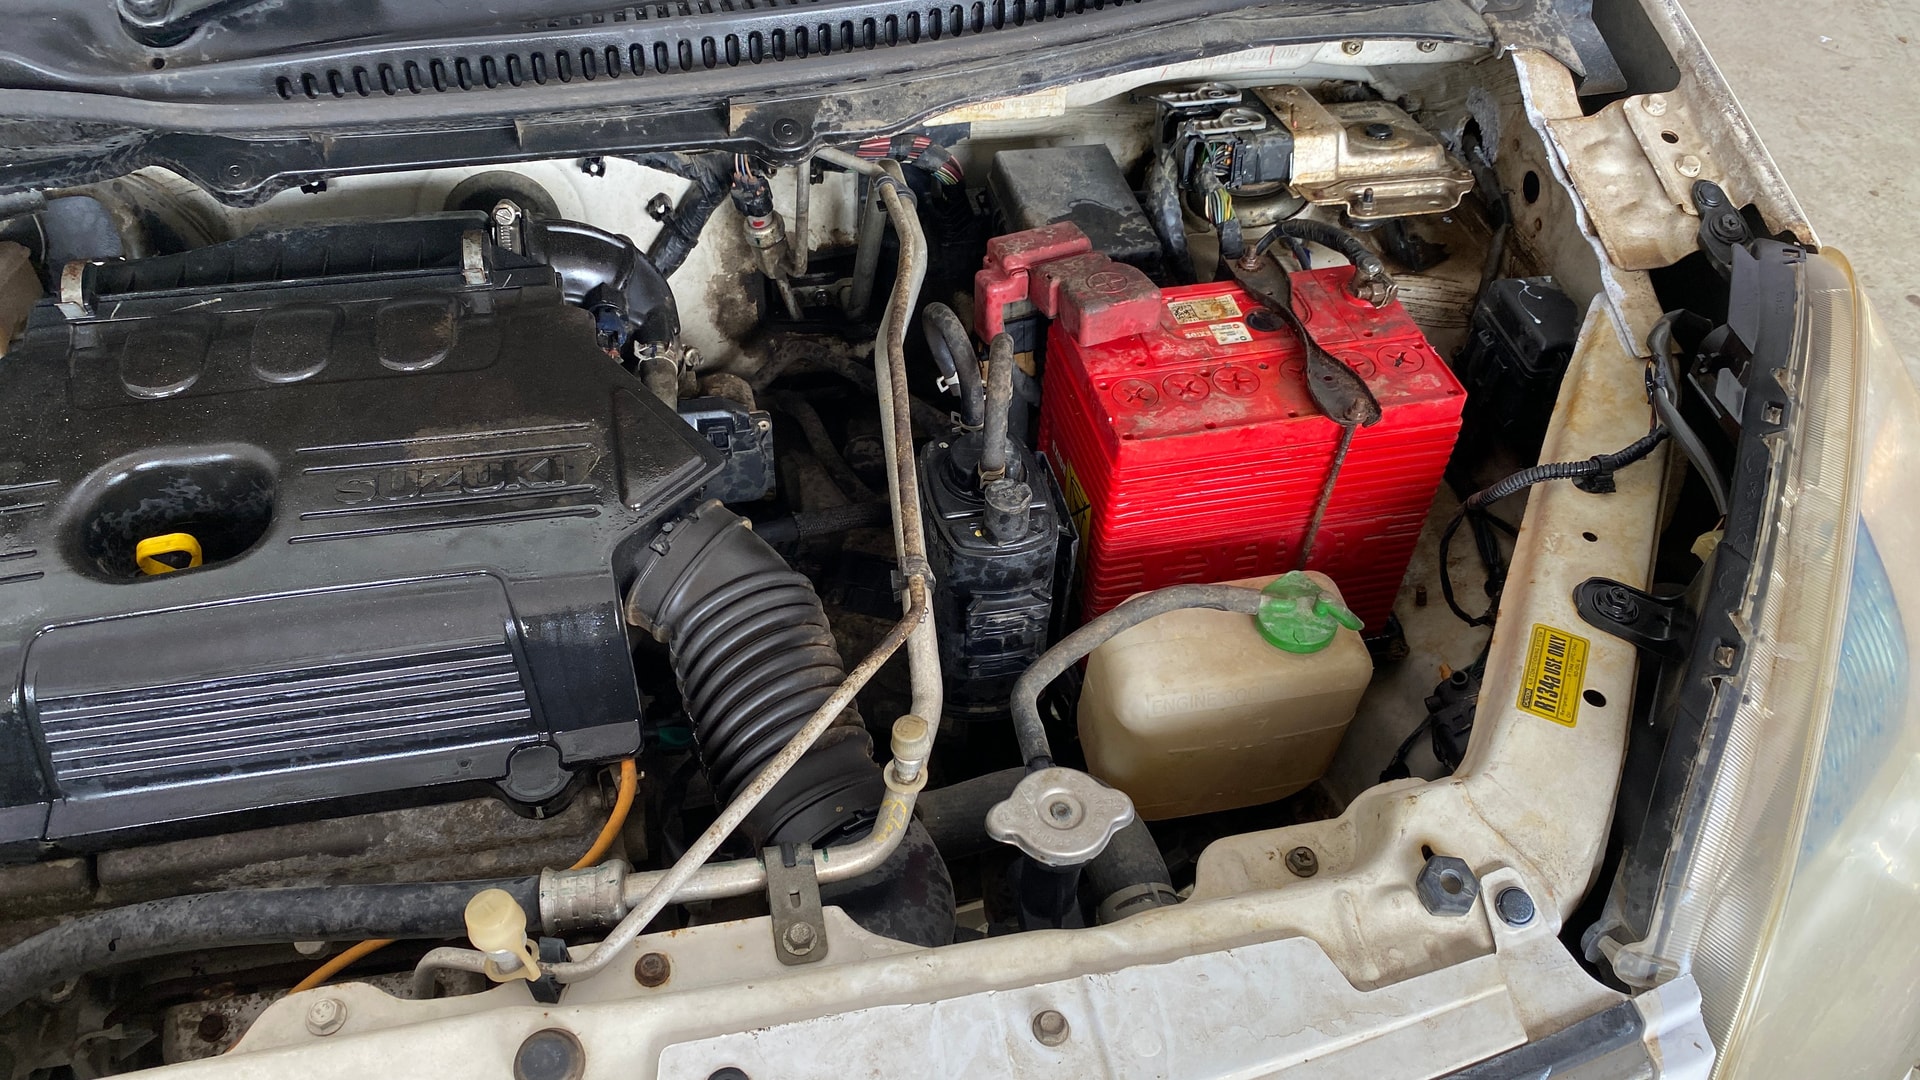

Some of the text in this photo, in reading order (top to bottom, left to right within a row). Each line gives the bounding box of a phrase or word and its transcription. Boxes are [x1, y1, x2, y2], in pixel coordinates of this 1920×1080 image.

[334, 456, 567, 505] SUZUKI
[1534, 634, 1567, 713] R134a USE ONLY
[1152, 692, 1217, 714] ENGINE
[1523, 689, 1532, 707] CAUTION
